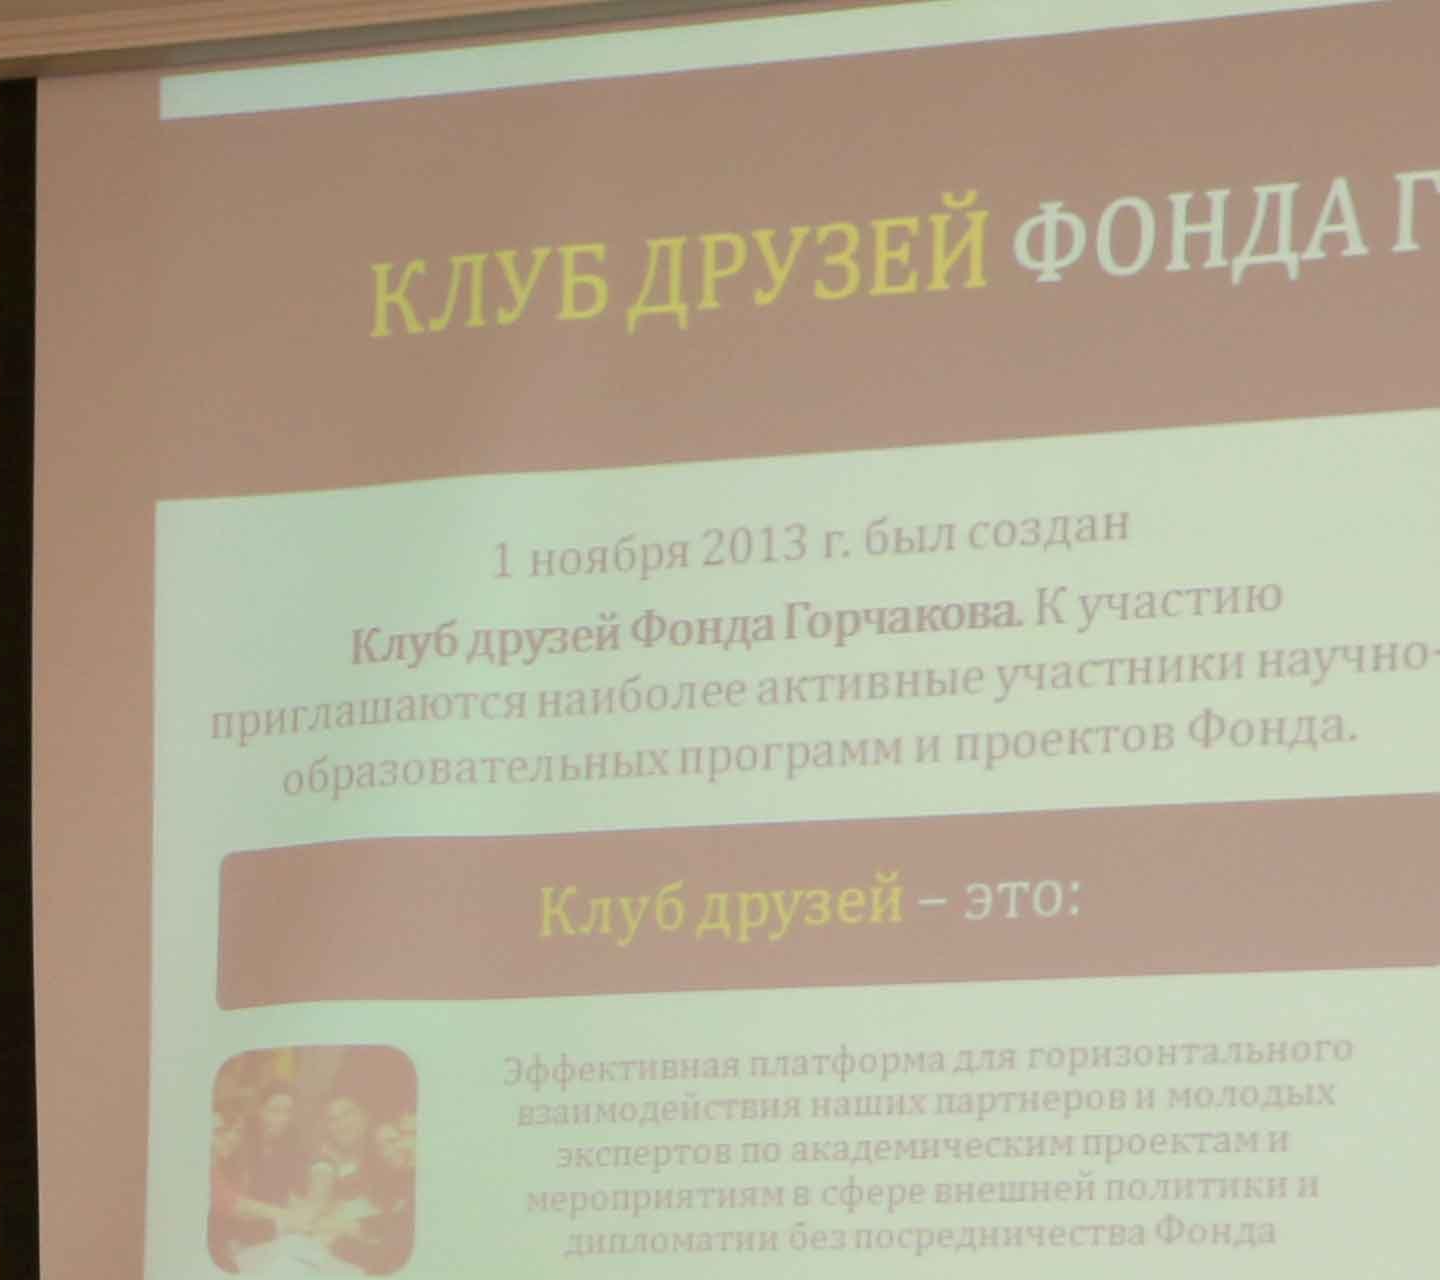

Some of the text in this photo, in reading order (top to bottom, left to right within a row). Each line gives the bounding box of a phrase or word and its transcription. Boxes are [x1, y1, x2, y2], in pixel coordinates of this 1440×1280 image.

[369, 242, 610, 338] КЛУБ
[626, 189, 989, 333] ДРУЗЕЙ
[1012, 175, 1368, 284] ФОНДА
[495, 509, 1131, 580] 1 ноября 2013 г. был создан
[350, 580, 1284, 669] Клуб друзей Фонда Горчакова. К участию
[210, 685, 528, 748] приглашаются
[536, 671, 748, 721] наиболее
[755, 664, 985, 708] активные
[991, 649, 1246, 703] участники
[282, 707, 1359, 801] образовательных программ и проектов Фонда.
[538, 879, 686, 947] Клуб
[695, 869, 905, 943] друзей
[963, 877, 1081, 921] это:
[502, 1036, 1356, 1093] Эффективная платформа для горизонтального
[516, 1082, 1337, 1128] взаимодействия наших партнеров и молодых
[557, 1129, 1290, 1174] экспертов по академическим проектам и
[526, 1169, 1321, 1221] мероприятиям в сфере внешней политики и
[561, 1213, 1278, 1258] дипломатии без посредничества Фонда
